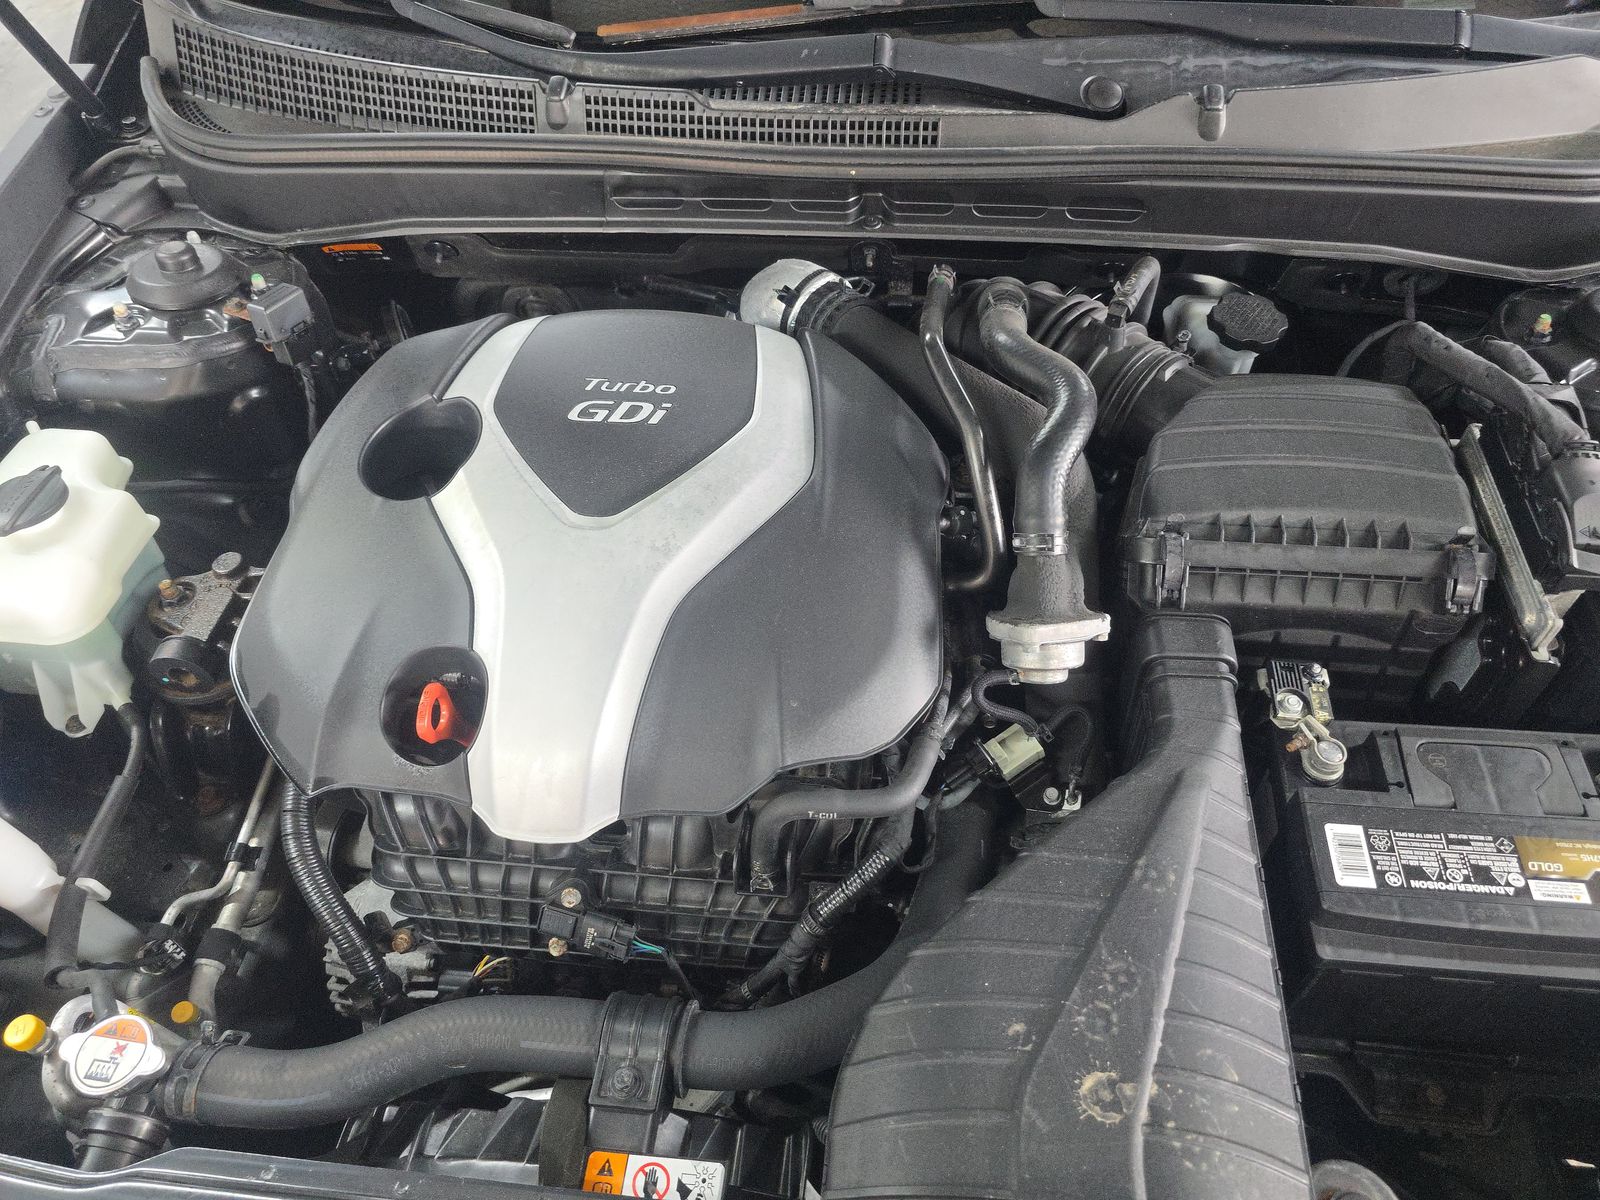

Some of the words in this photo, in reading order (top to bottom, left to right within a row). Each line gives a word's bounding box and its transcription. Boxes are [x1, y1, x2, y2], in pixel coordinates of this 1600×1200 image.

[585, 378, 677, 394] Turbo
[567, 400, 673, 425] GDi
[1528, 861, 1563, 872] GOLD
